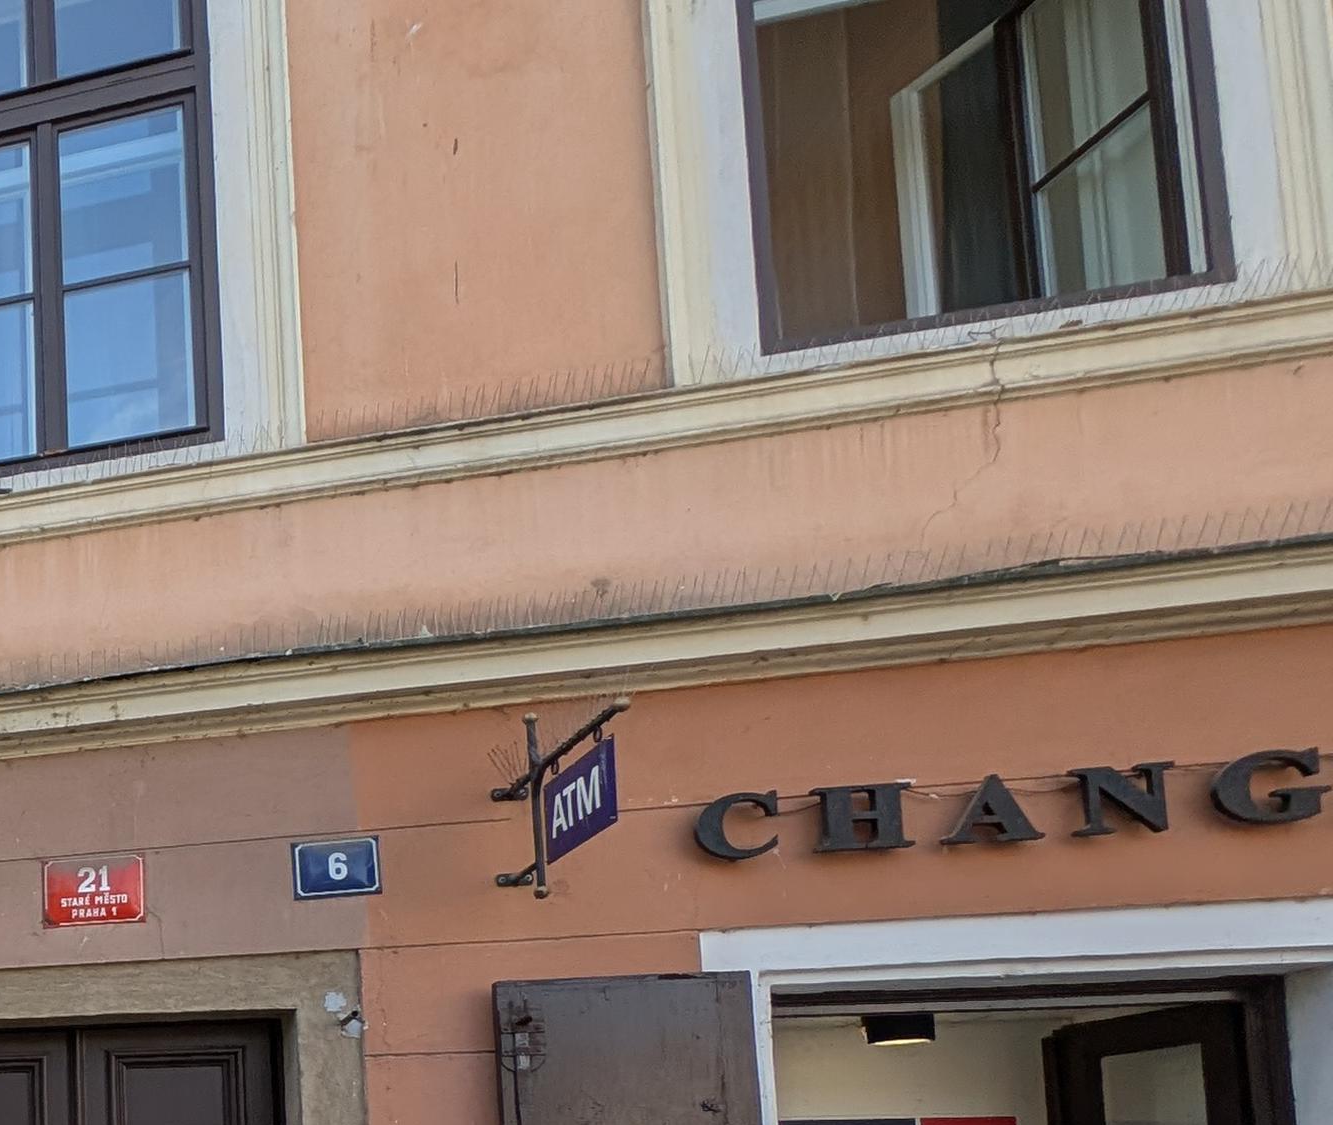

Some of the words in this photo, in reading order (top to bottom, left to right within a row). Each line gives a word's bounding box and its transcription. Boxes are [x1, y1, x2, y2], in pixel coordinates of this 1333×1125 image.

[552, 765, 601, 839] ATM
[694, 747, 1331, 861] CHANG
[77, 865, 111, 893] 21
[328, 852, 348, 880] 6
[60, 894, 91, 908] STARÉ
[94, 892, 128, 905] MĚSTO
[71, 907, 107, 919] PRAHA
[111, 906, 118, 916] 1
